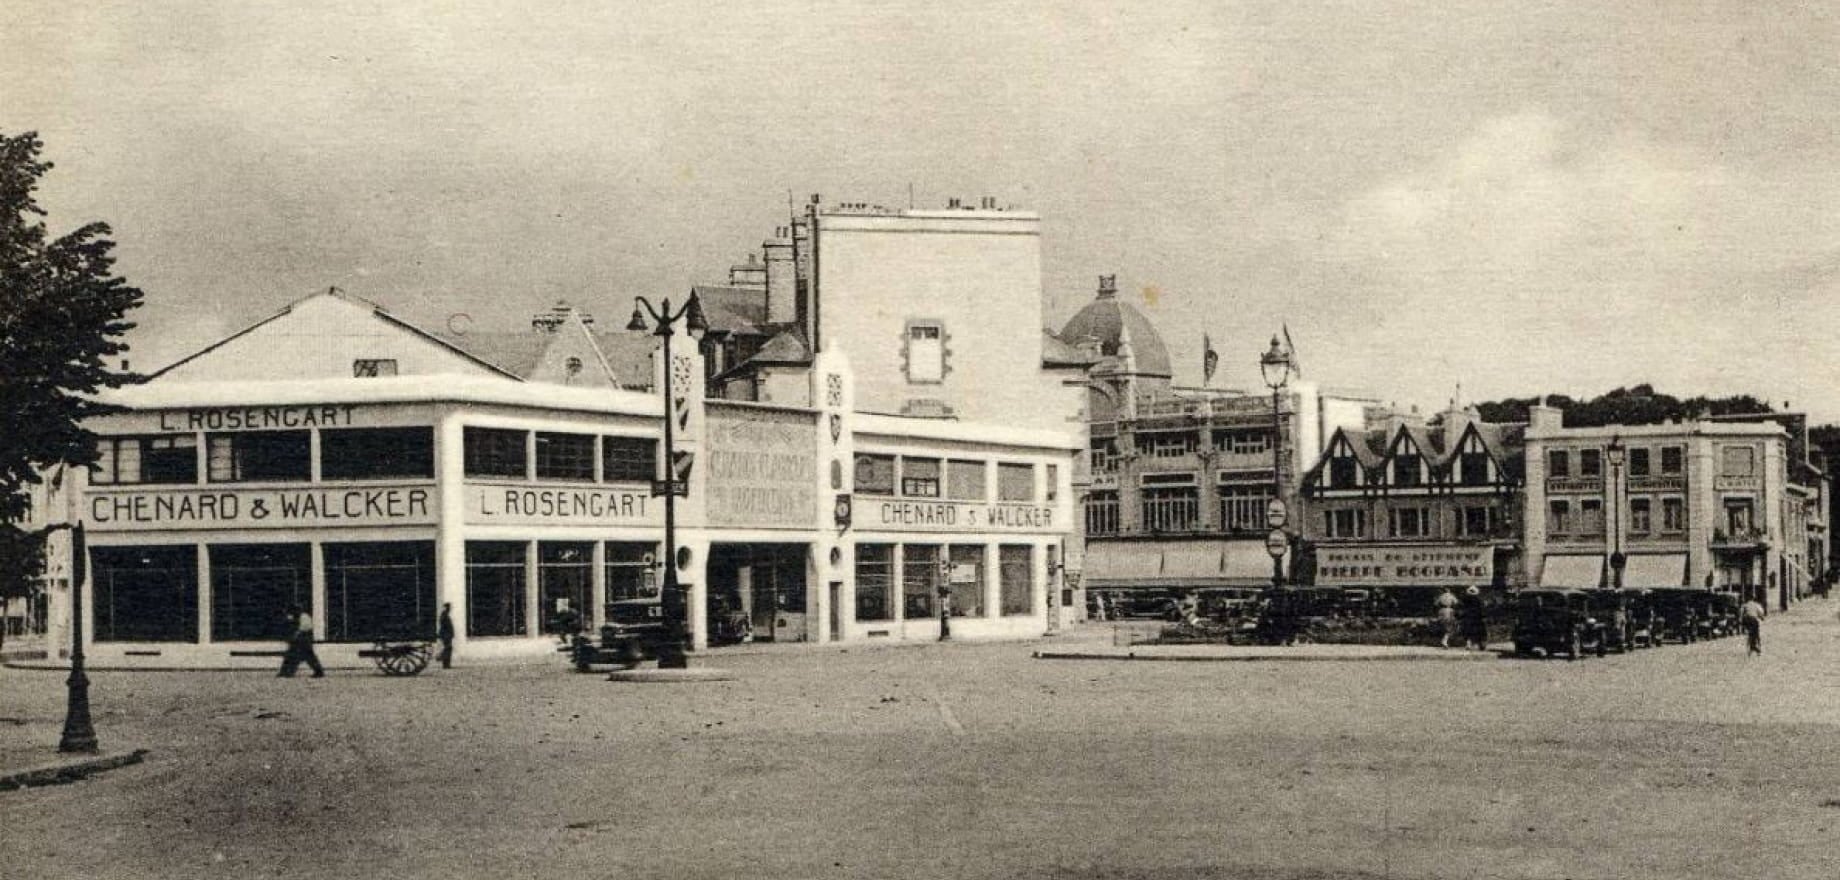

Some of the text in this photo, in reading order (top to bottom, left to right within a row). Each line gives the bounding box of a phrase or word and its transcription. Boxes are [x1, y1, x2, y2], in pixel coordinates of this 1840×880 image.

[188, 405, 355, 430] ROSENGART
[91, 490, 430, 523] CHENARD & WALCKER
[505, 489, 649, 518] ROSENGART
[880, 502, 957, 526] CHENARD
[987, 506, 1053, 528] WALCKER
